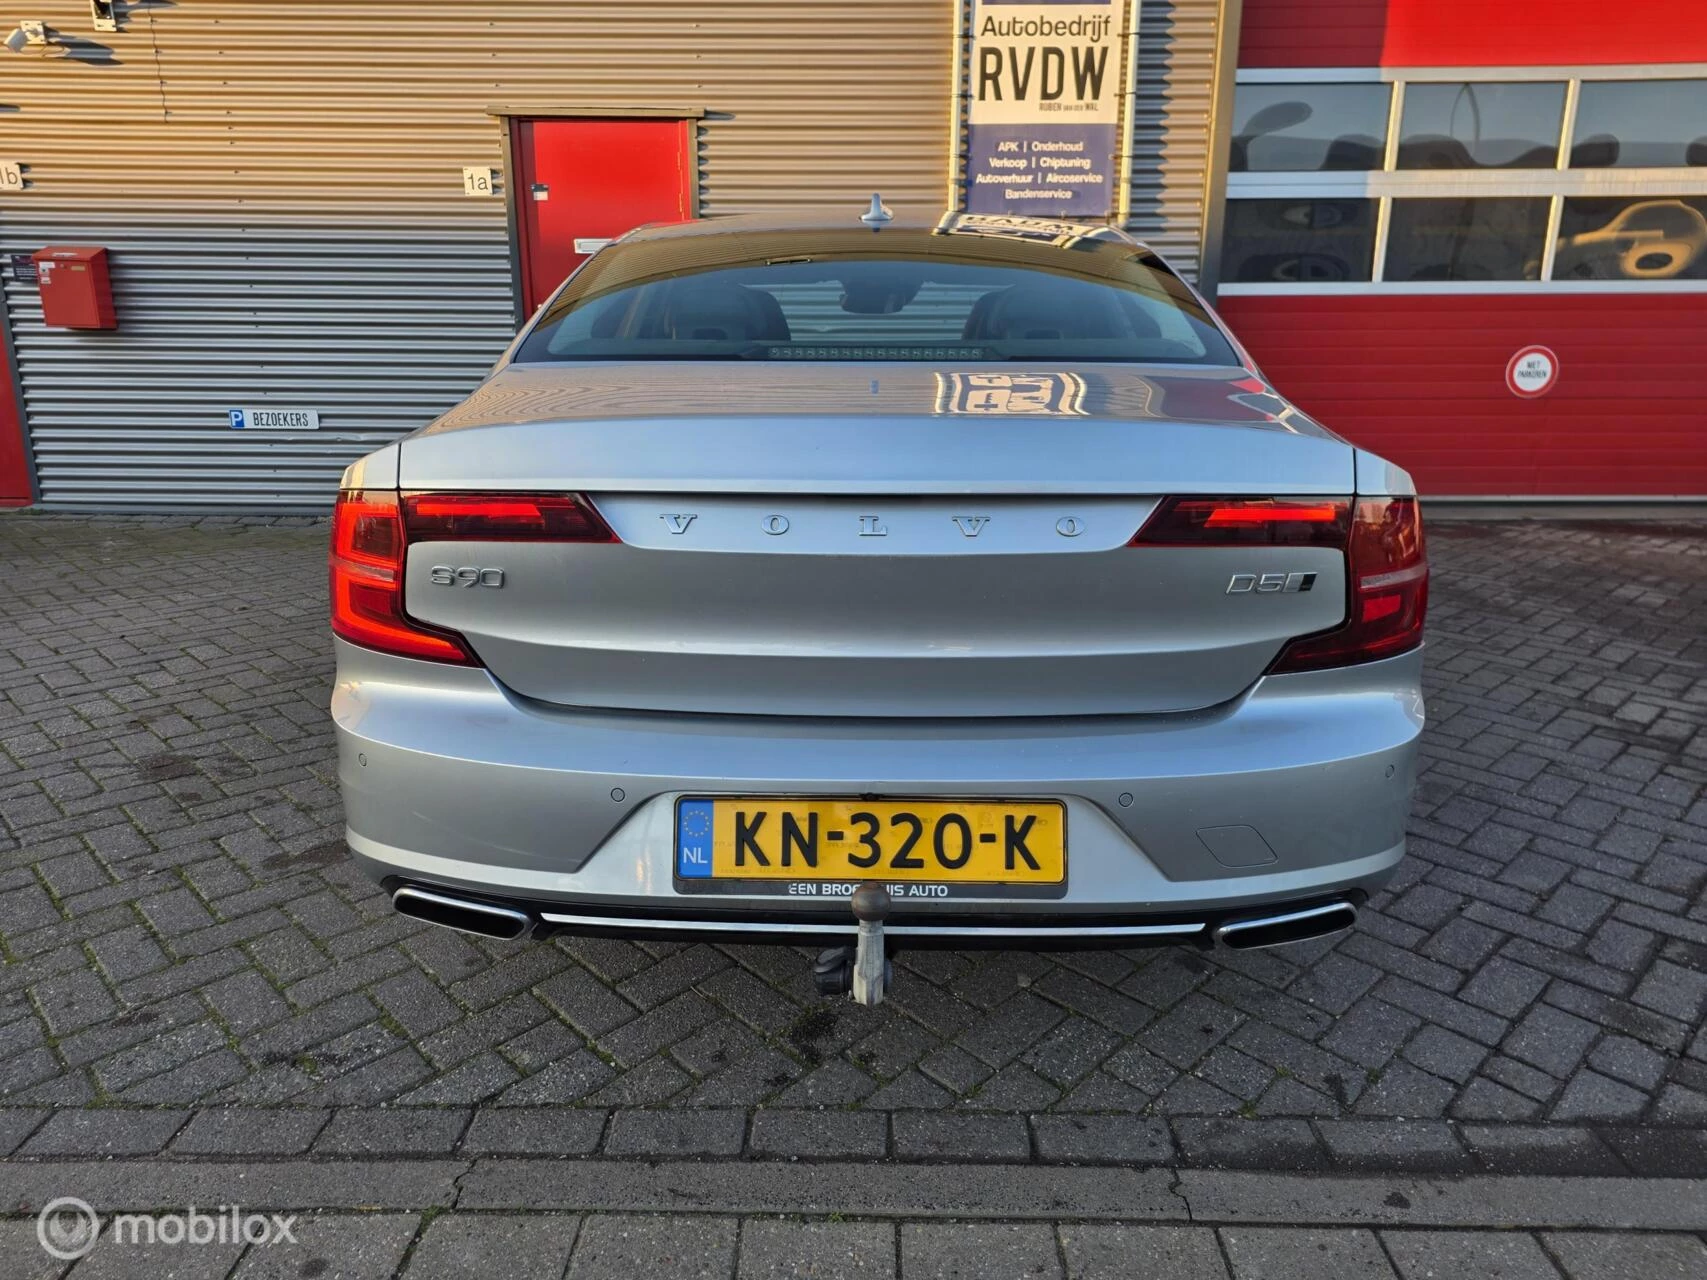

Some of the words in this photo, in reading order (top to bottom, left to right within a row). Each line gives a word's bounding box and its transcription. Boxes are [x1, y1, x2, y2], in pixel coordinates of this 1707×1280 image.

[981, 15, 1111, 43] Autobedrijf
[978, 46, 1109, 101] RVDW
[998, 142, 1019, 152] APK
[1031, 141, 1084, 152] Onderhoud
[989, 157, 1027, 170] Verkoop
[1040, 157, 1091, 170] Chiptuning
[467, 173, 488, 190] 1a
[976, 173, 1033, 184] Autoverhuur
[1046, 173, 1103, 183] Aircoservice
[1005, 189, 1072, 199] Bandenservice
[229, 411, 243, 427] P
[253, 412, 309, 427] BEZOEKERS
[659, 513, 1086, 537] VOLVO
[431, 565, 505, 589] S90
[734, 811, 1041, 870] KN-320-K
[683, 847, 708, 865] NL
[908, 884, 948, 897] AUTO
